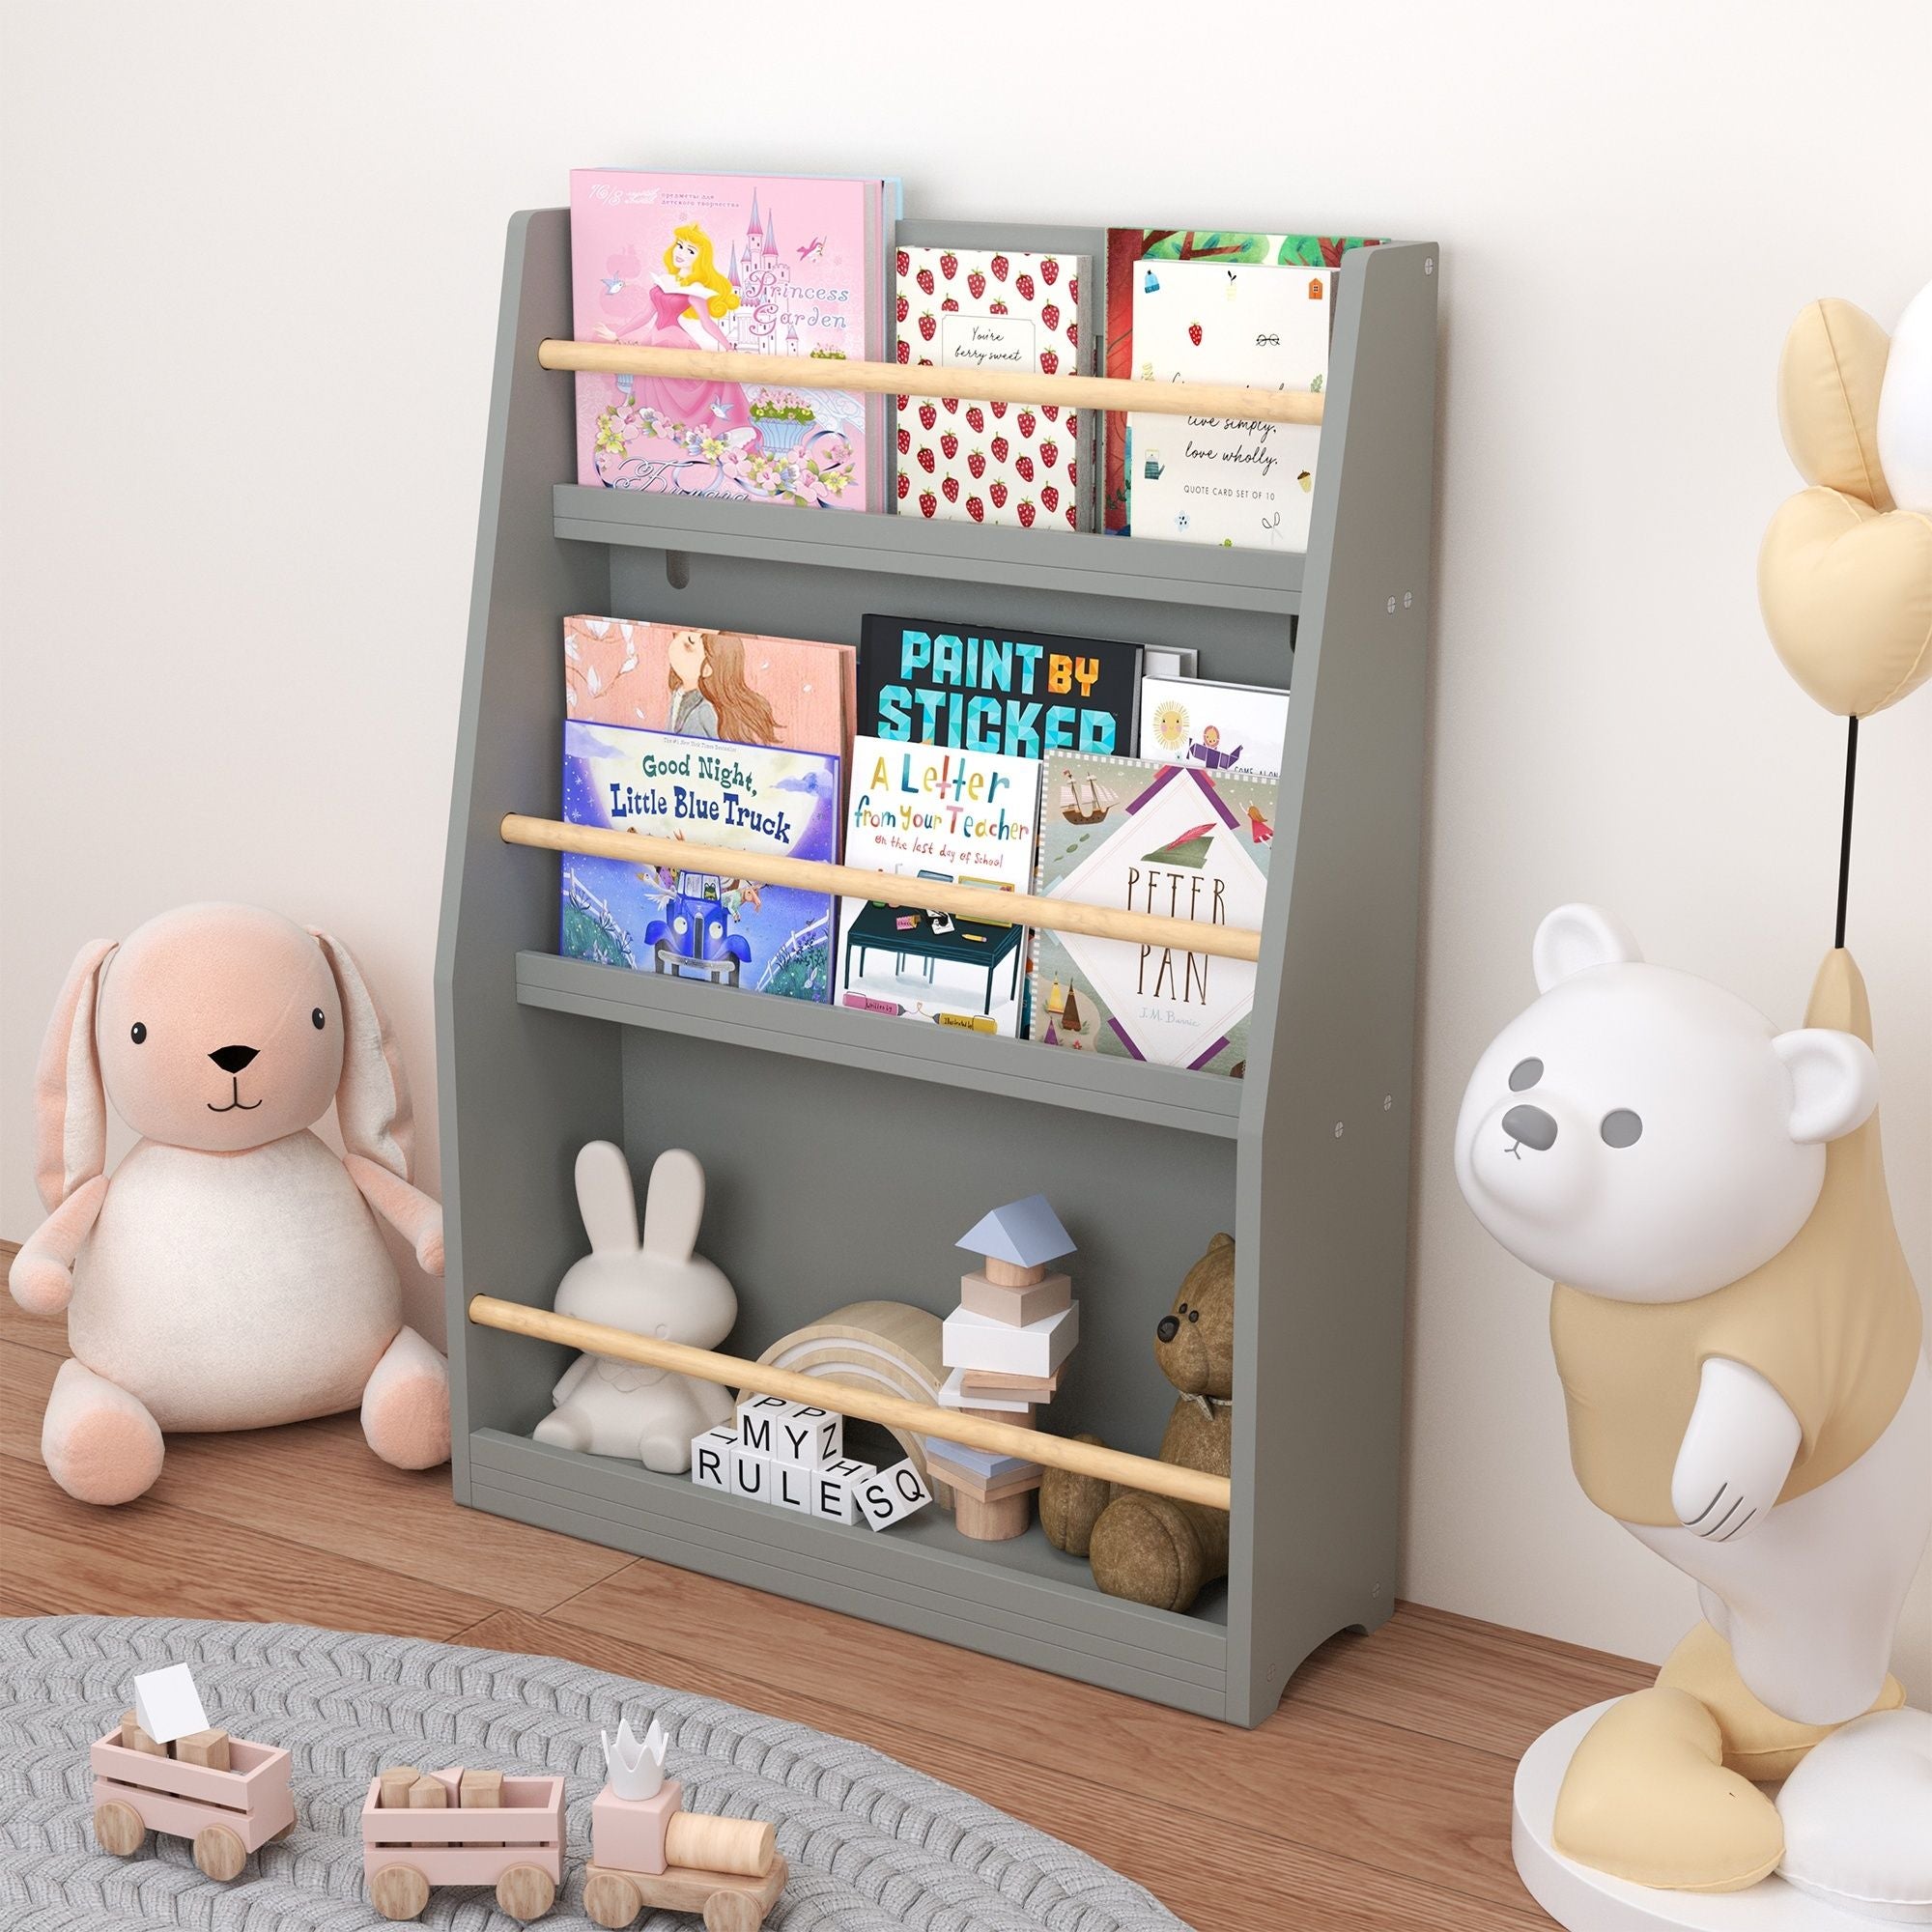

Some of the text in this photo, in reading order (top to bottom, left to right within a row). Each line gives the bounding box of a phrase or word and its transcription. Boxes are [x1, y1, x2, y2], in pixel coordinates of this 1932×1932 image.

[746, 270, 850, 301] Princess
[749, 304, 847, 336] Garden
[972, 327, 1005, 341] You're
[954, 345, 1022, 365] berry sweet
[1185, 440, 1278, 476] love wholly.
[1183, 485, 1276, 501] QUOTE CARD SET OF 10
[900, 630, 1099, 696] PAINT BY
[877, 684, 1117, 760] STICKER
[642, 754, 757, 797] Good Night,
[870, 753, 1009, 803] A Letter
[610, 783, 791, 843] Little Blue Truck
[855, 795, 896, 828] from
[947, 805, 1030, 840] Teacher
[891, 836, 907, 850] the
[913, 837, 933, 855] last
[939, 844, 956, 863] day
[960, 852, 971, 865] of
[1128, 867, 1226, 925] PETER
[1136, 944, 1208, 1006] PAN
[743, 1414, 809, 1459] MY
